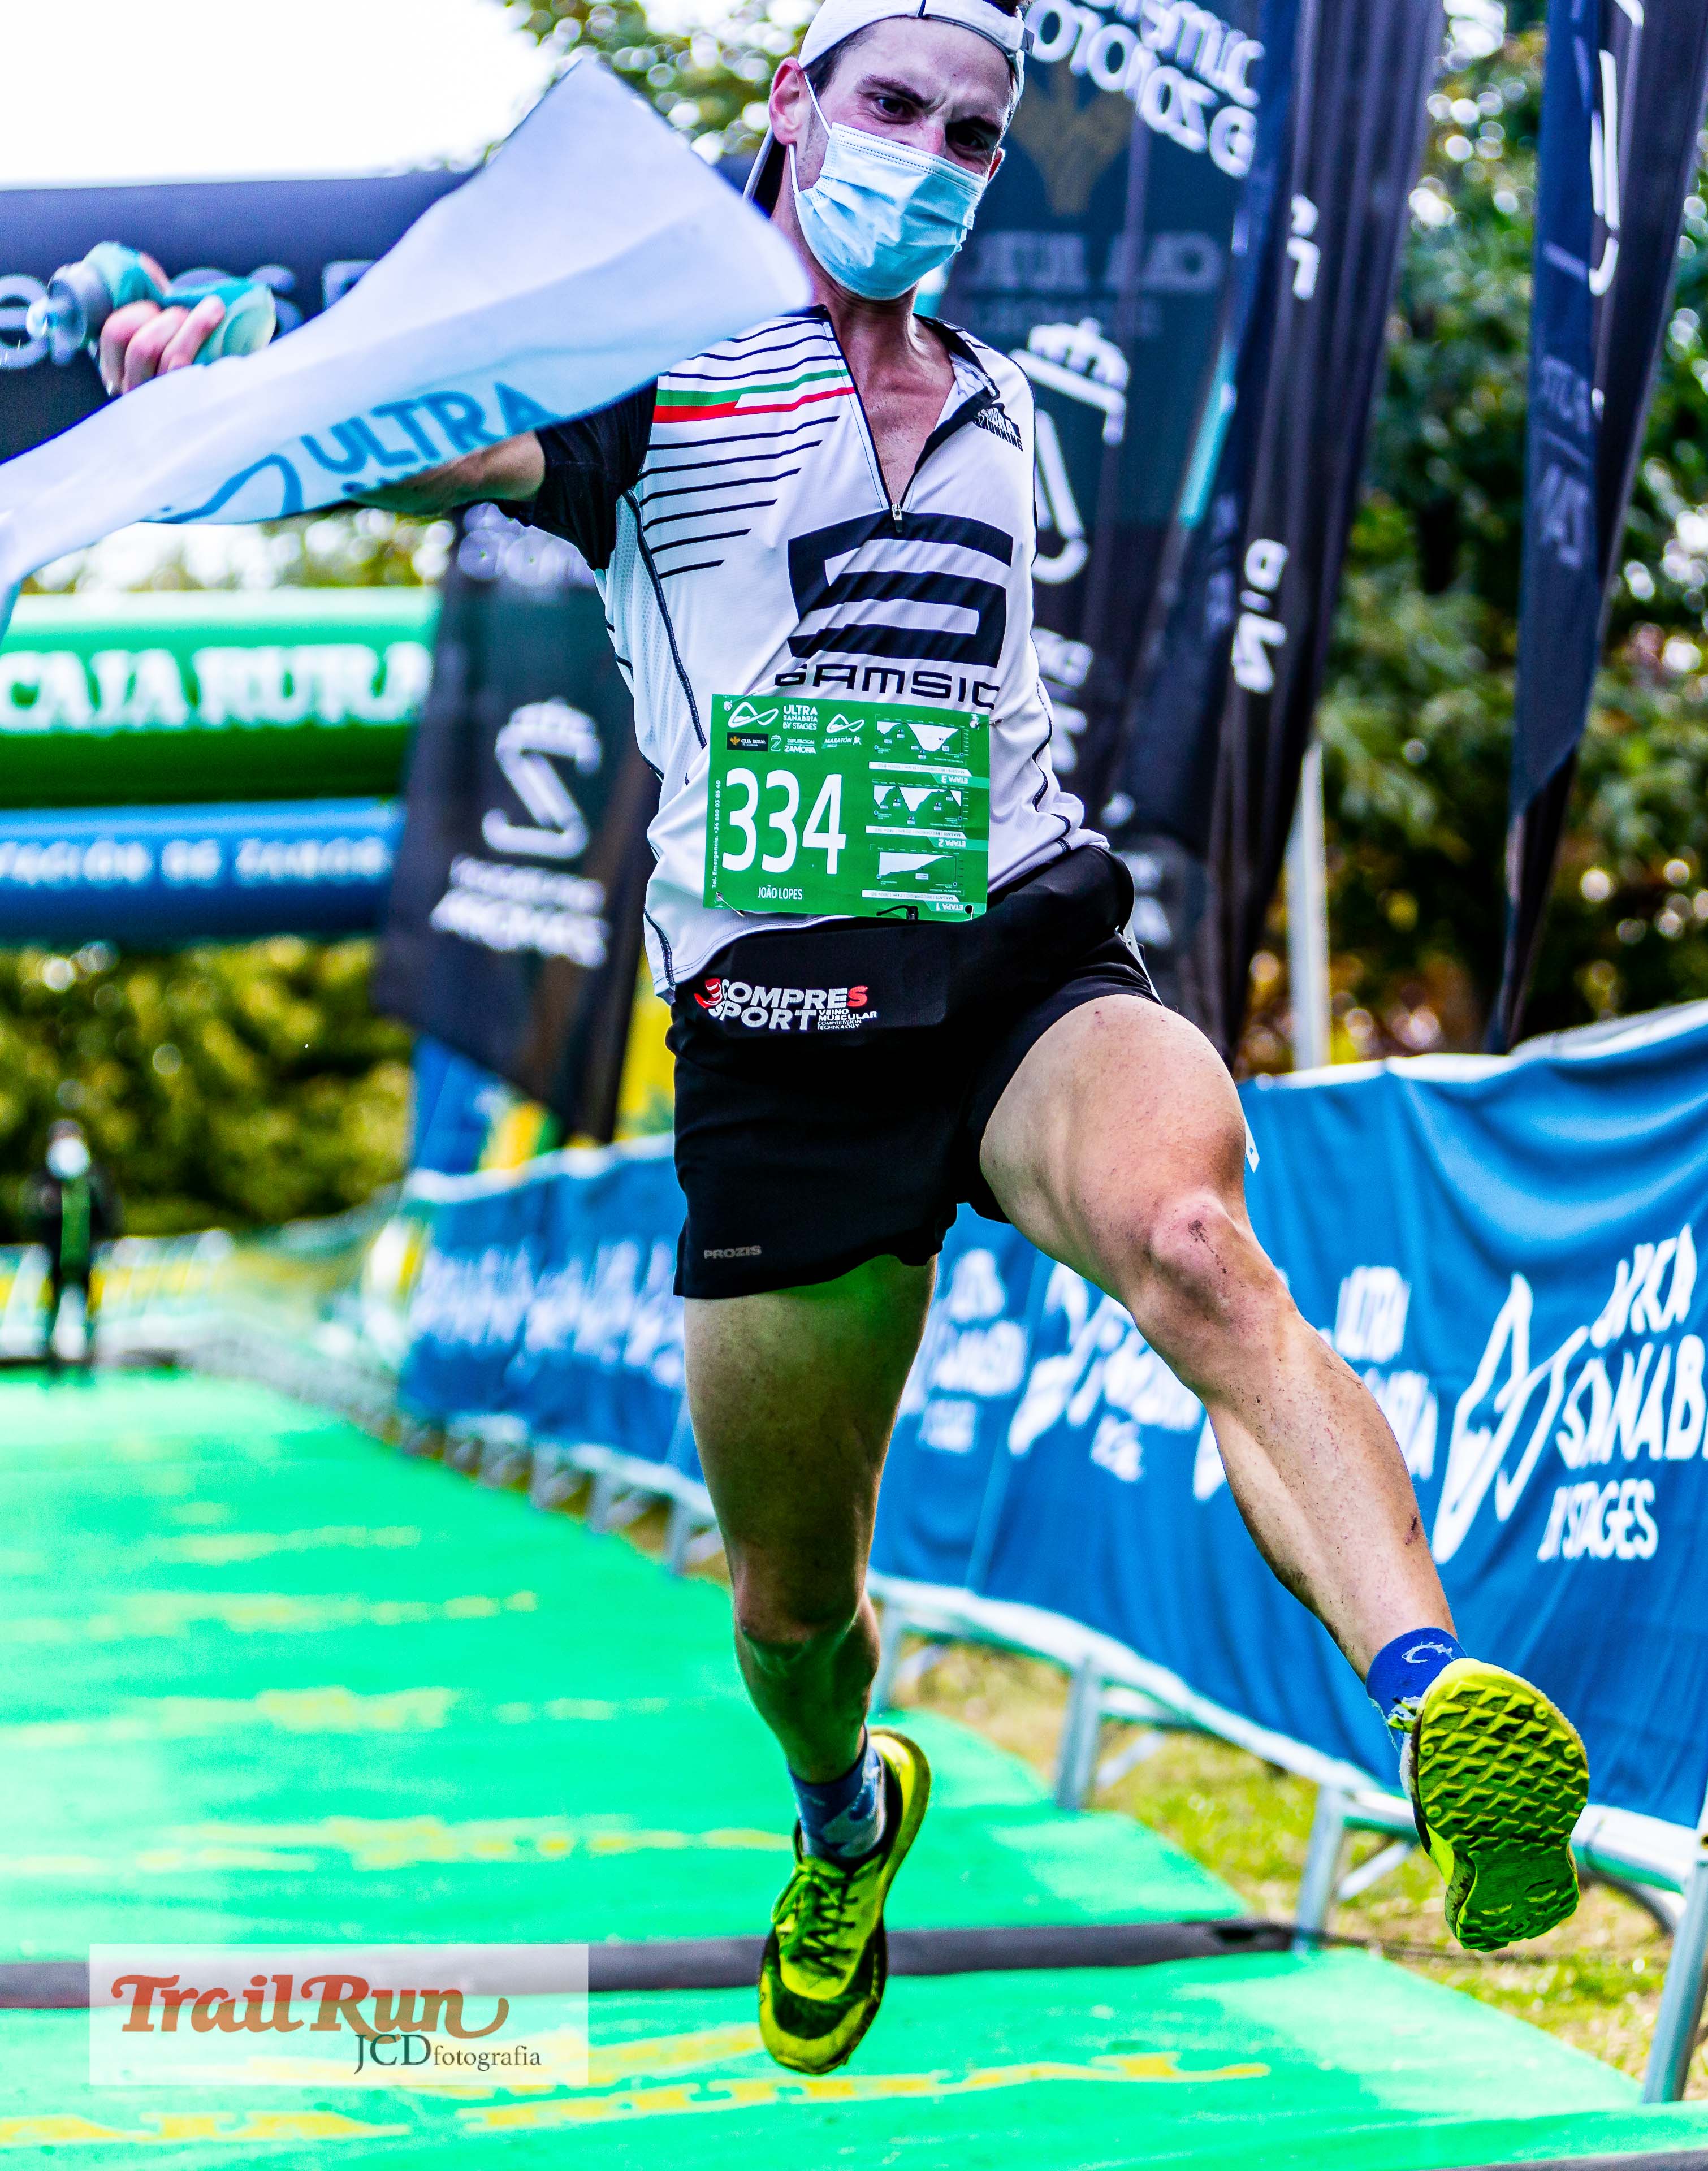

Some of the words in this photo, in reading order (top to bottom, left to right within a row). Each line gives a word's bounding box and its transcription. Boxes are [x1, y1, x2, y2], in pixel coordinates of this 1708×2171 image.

[300, 382, 559, 475] ULTRA
[783, 705, 818, 716] ULTRA
[793, 722, 817, 730] STAGES
[784, 745, 816, 754] ZAMORA
[715, 780, 721, 789] 40
[941, 775, 947, 784] 3
[721, 768, 846, 875] 334
[938, 838, 944, 847] 2
[945, 839, 966, 847] ETAPA
[758, 884, 777, 898] JOÃO
[779, 888, 803, 900] LOPES
[936, 902, 940, 911] 1
[942, 903, 964, 911] ETAPA
[721, 979, 869, 1009] COMPRES
[708, 1000, 817, 1031] SPORT
[818, 1011, 877, 1022] MUSCULAR
[703, 1245, 762, 1259] PROZIS
[1556, 1334, 1708, 1470] SANAB
